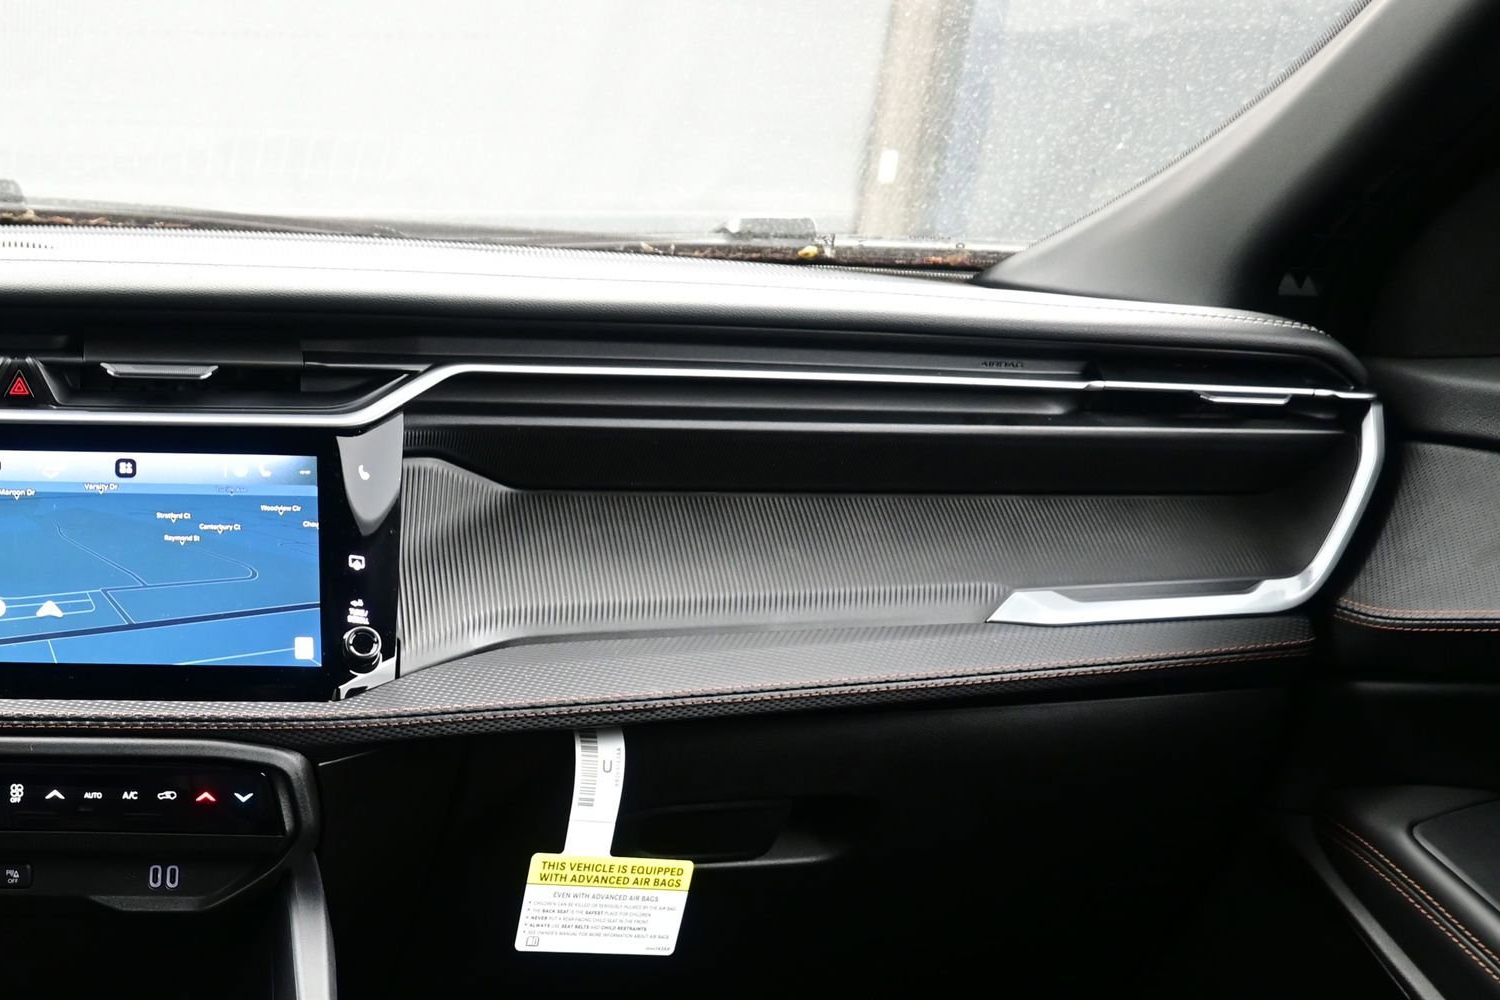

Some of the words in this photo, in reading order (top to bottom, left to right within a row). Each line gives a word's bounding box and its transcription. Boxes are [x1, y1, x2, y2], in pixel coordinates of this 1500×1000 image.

[603, 759, 614, 774] U
[83, 791, 103, 799] AUTO
[122, 791, 139, 800] A/C
[542, 861, 566, 871] THIS
[569, 863, 616, 874] VEHICLE
[617, 865, 628, 874] IS
[630, 865, 684, 876] EQUIPPED
[539, 873, 567, 882] WITH
[570, 875, 630, 886] ADVANCED
[632, 877, 651, 886] AIR
[653, 878, 682, 888] BAGS
[591, 893, 628, 901] ADVANCED
